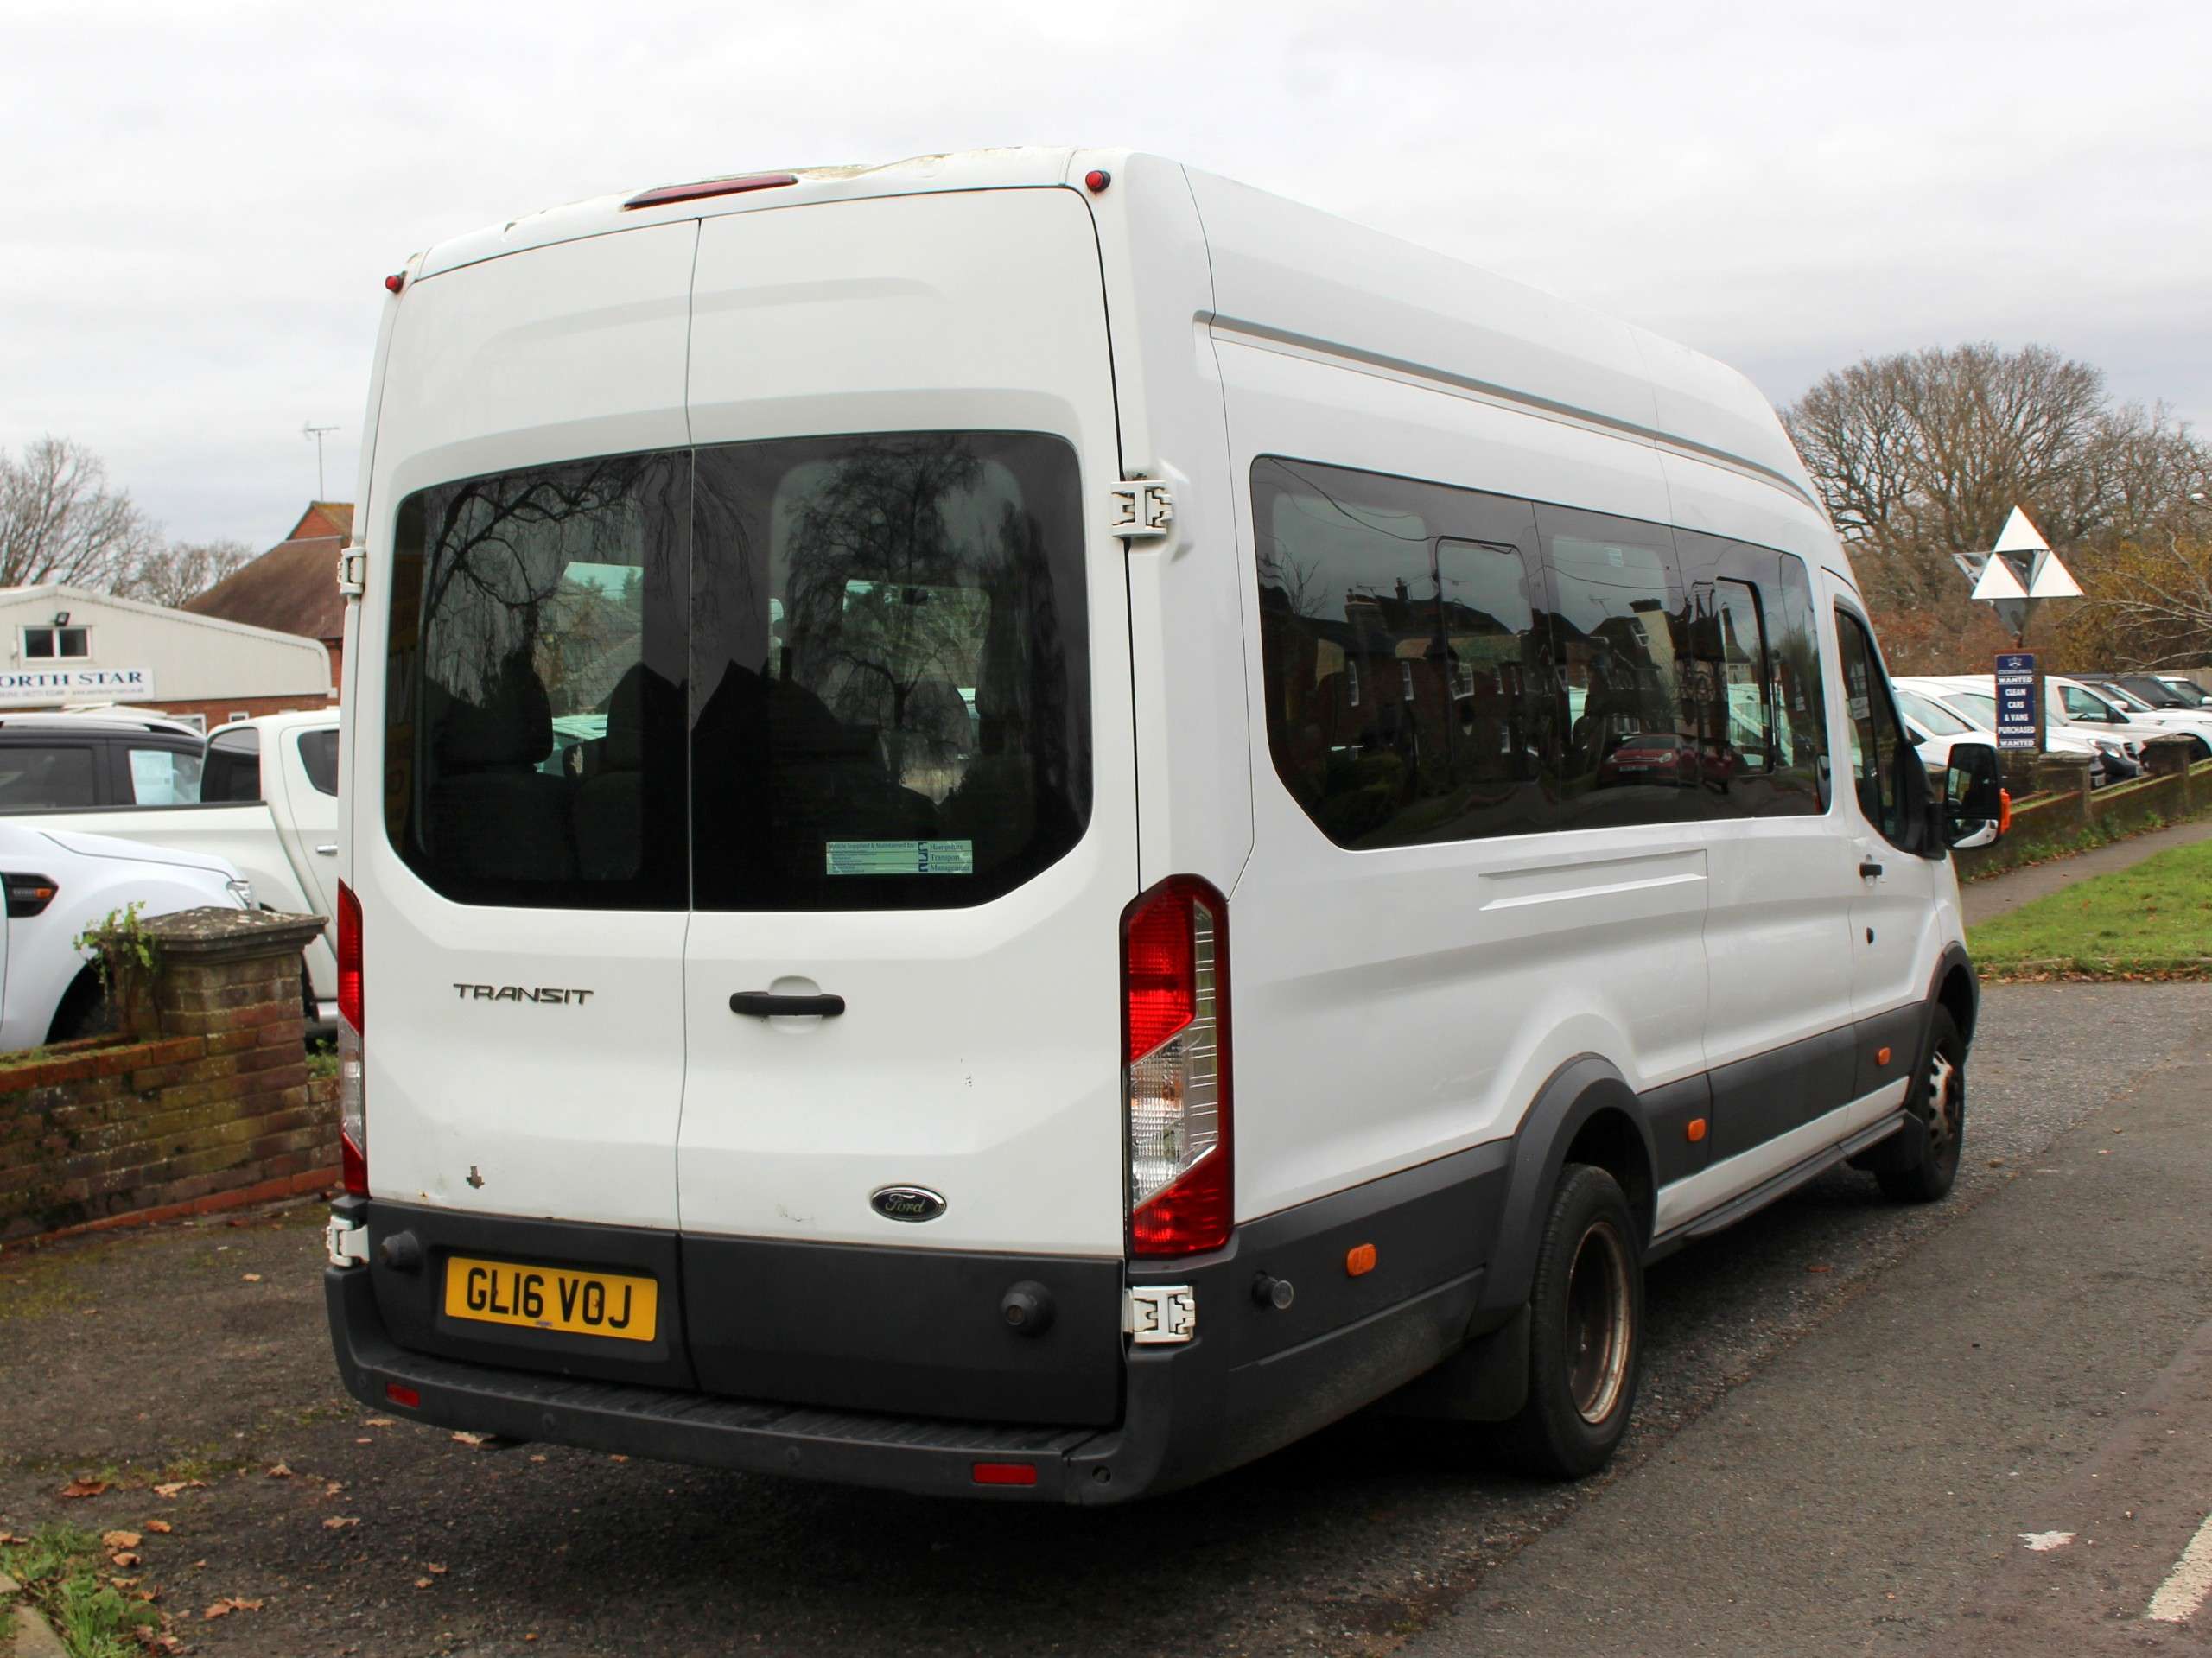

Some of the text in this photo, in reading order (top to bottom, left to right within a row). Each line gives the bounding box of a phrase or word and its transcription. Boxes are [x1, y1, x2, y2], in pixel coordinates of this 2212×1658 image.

[79, 671, 143, 685] STAR
[1998, 726, 2035, 734] PURCHASED
[931, 854, 960, 862] Transport
[453, 983, 594, 1006] TRANSIT
[885, 1193, 926, 1213] Ford
[467, 1267, 632, 1330] GL16 VOJ
